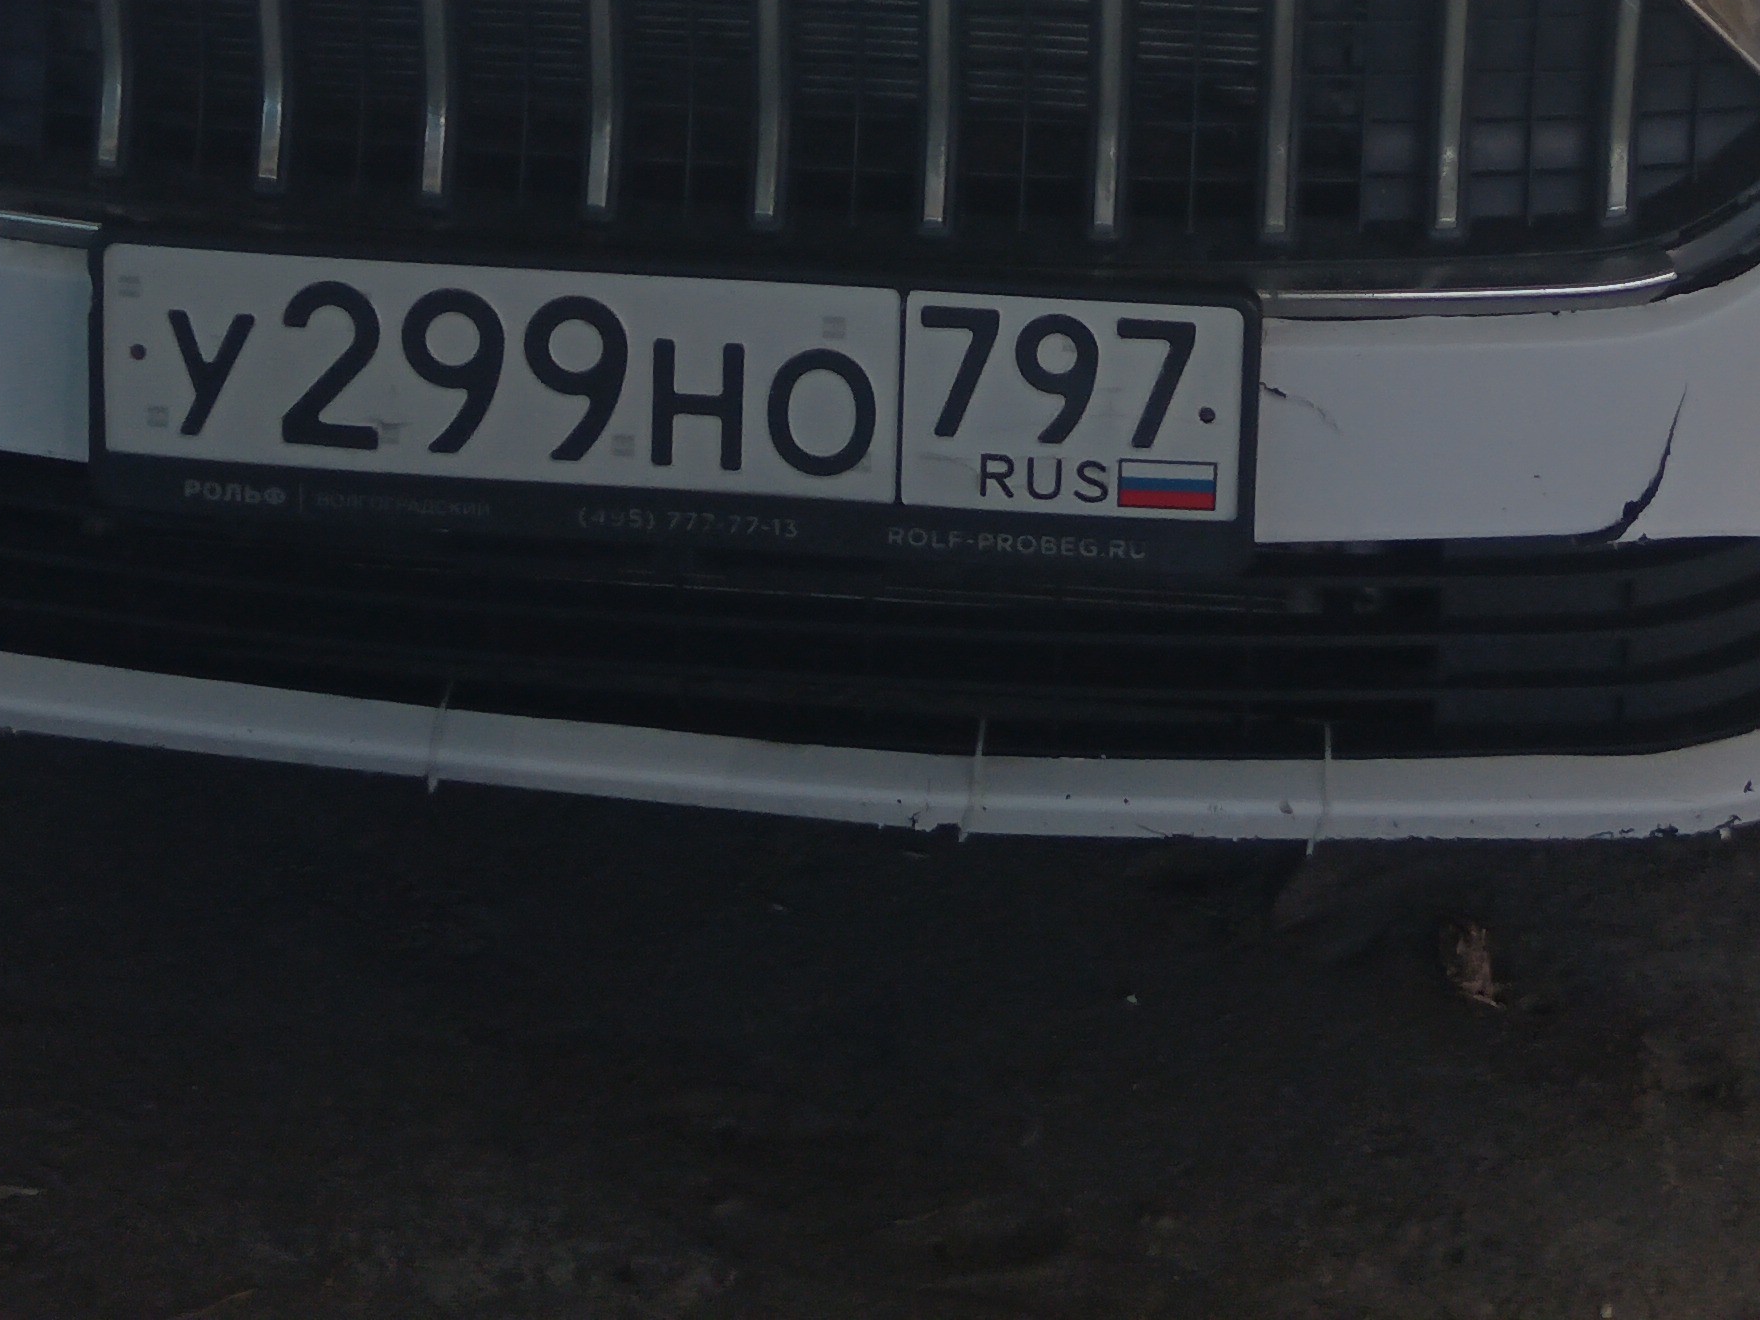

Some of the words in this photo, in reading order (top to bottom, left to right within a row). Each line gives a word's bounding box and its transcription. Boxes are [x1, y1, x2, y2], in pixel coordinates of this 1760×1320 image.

[919, 304, 1197, 450] 797
[183, 478, 287, 506] РОЛЬФ
[978, 452, 1111, 504] RUS
